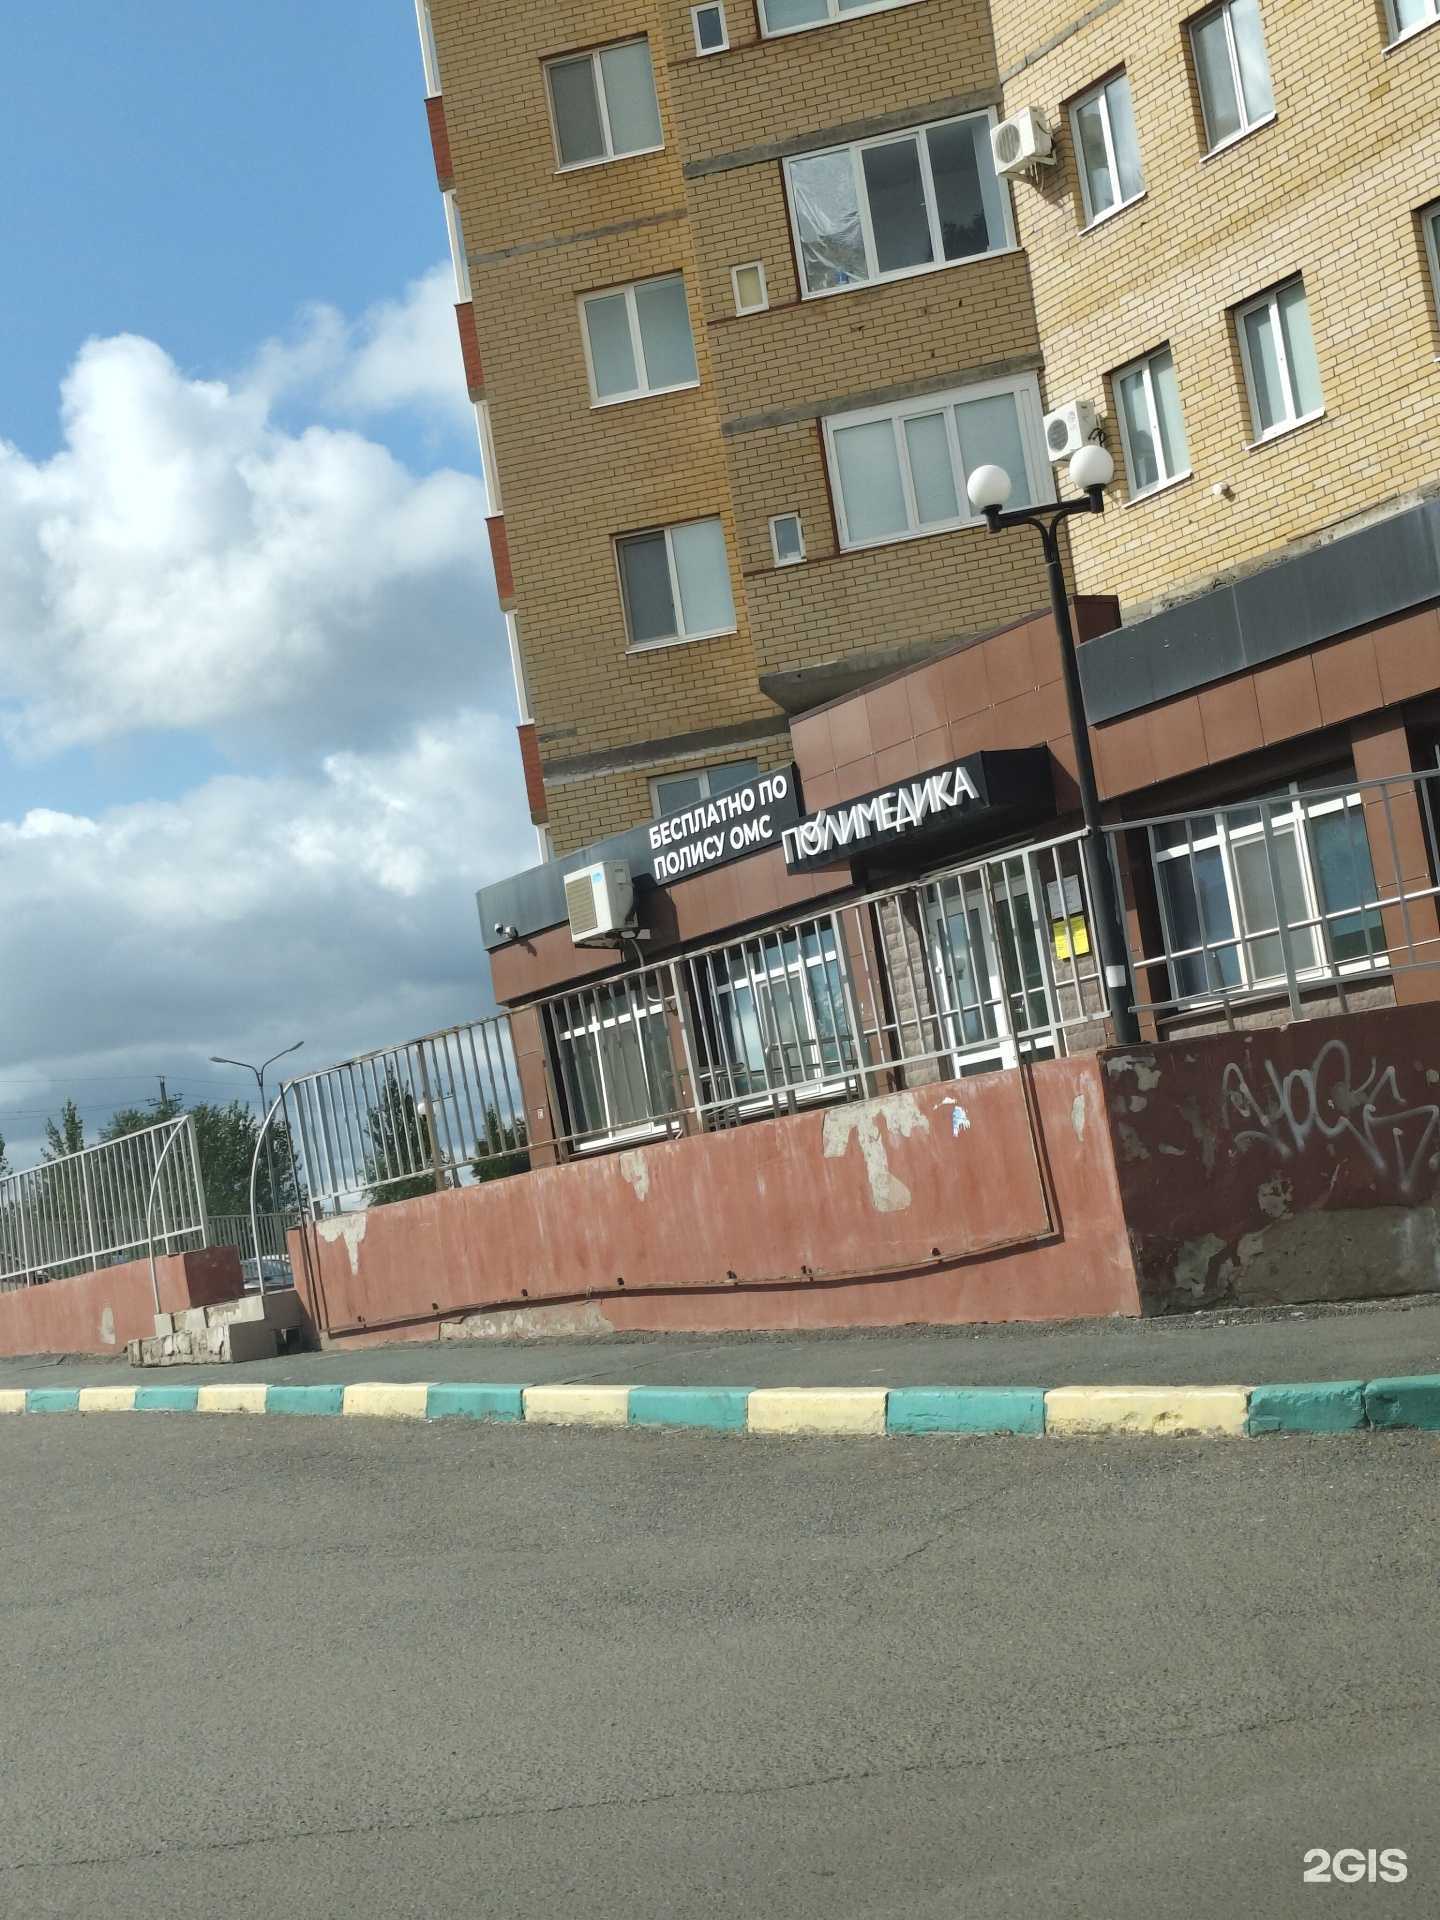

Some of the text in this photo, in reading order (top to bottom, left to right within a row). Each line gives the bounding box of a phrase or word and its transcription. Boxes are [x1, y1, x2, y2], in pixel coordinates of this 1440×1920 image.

[649, 775, 788, 850] БЕСПЛАТНО ПО
[653, 815, 773, 880] ПОЛИСУ ОМС
[781, 766, 980, 864] ПОЛИМЕДИКА
